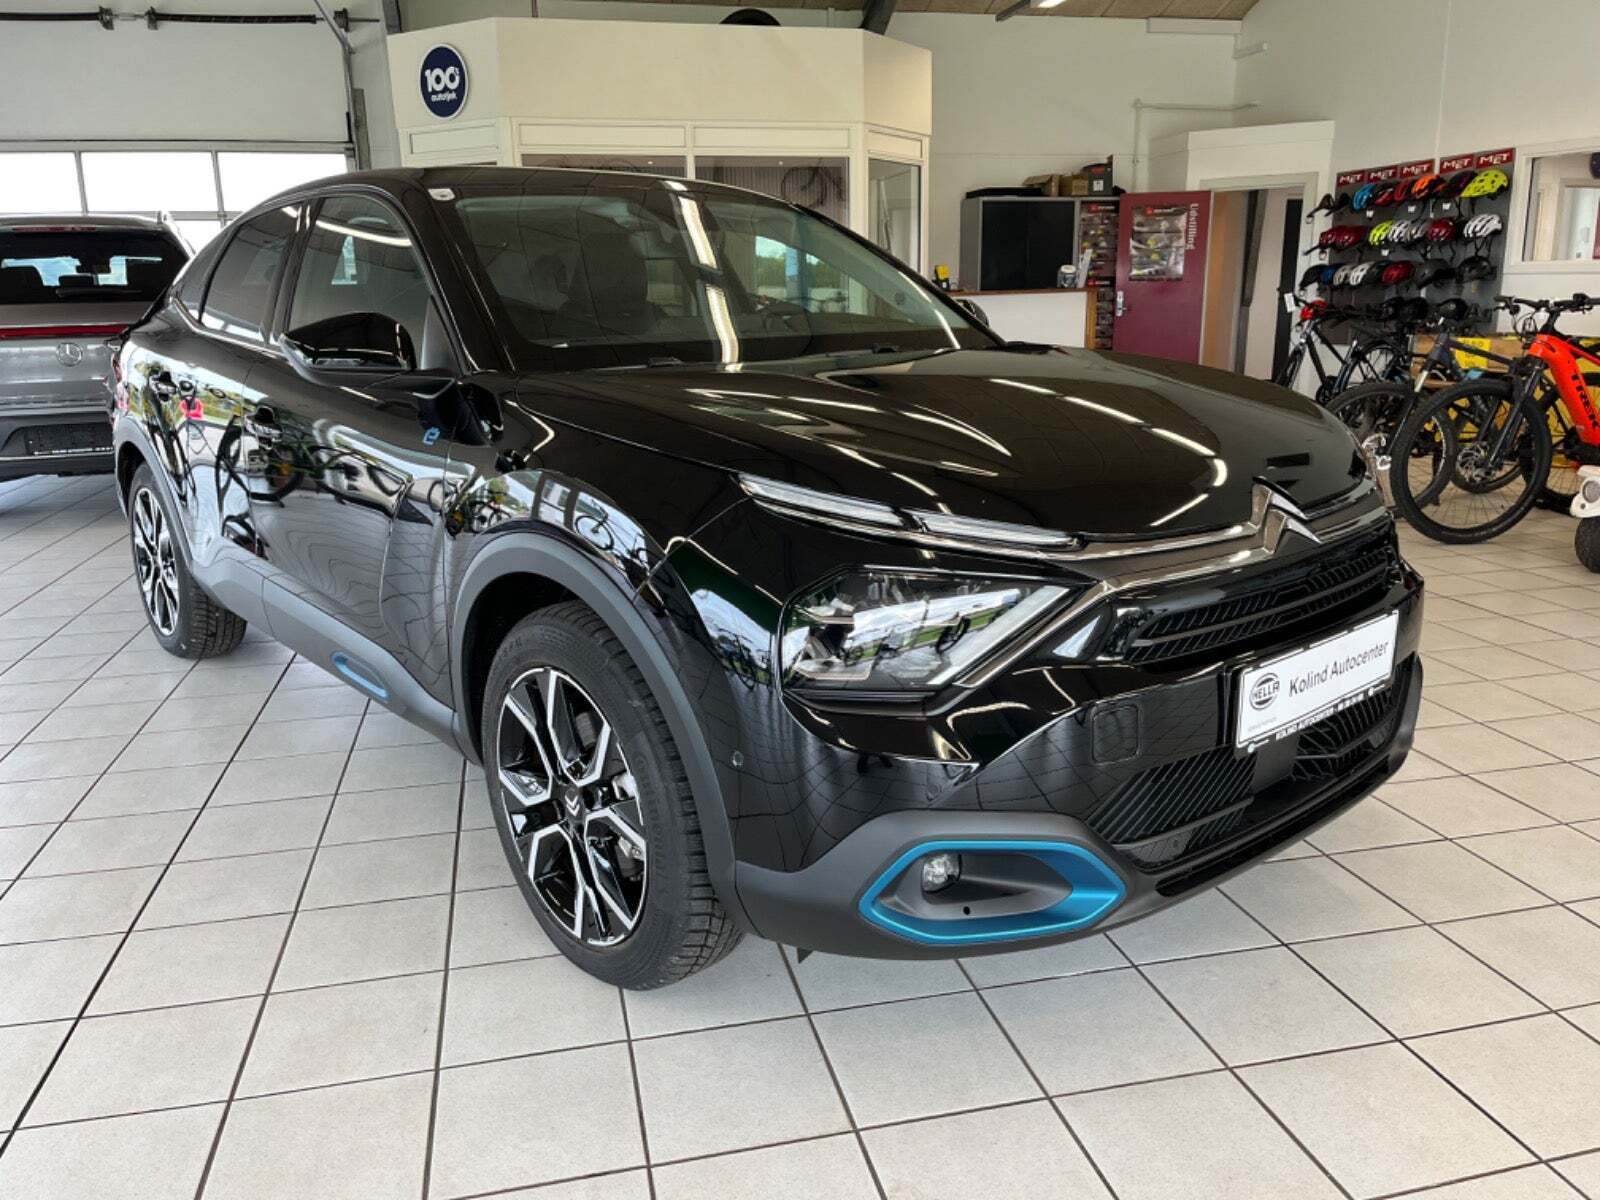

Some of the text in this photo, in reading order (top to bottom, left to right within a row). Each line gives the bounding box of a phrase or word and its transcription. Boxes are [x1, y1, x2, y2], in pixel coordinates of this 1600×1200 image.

[1443, 158, 1472, 169] MET
[1479, 152, 1510, 165] MET
[1403, 163, 1430, 174] MET
[1339, 174, 1362, 184] MET
[1370, 169, 1395, 180] MET
[1289, 641, 1389, 697] Kolind Autocenter
